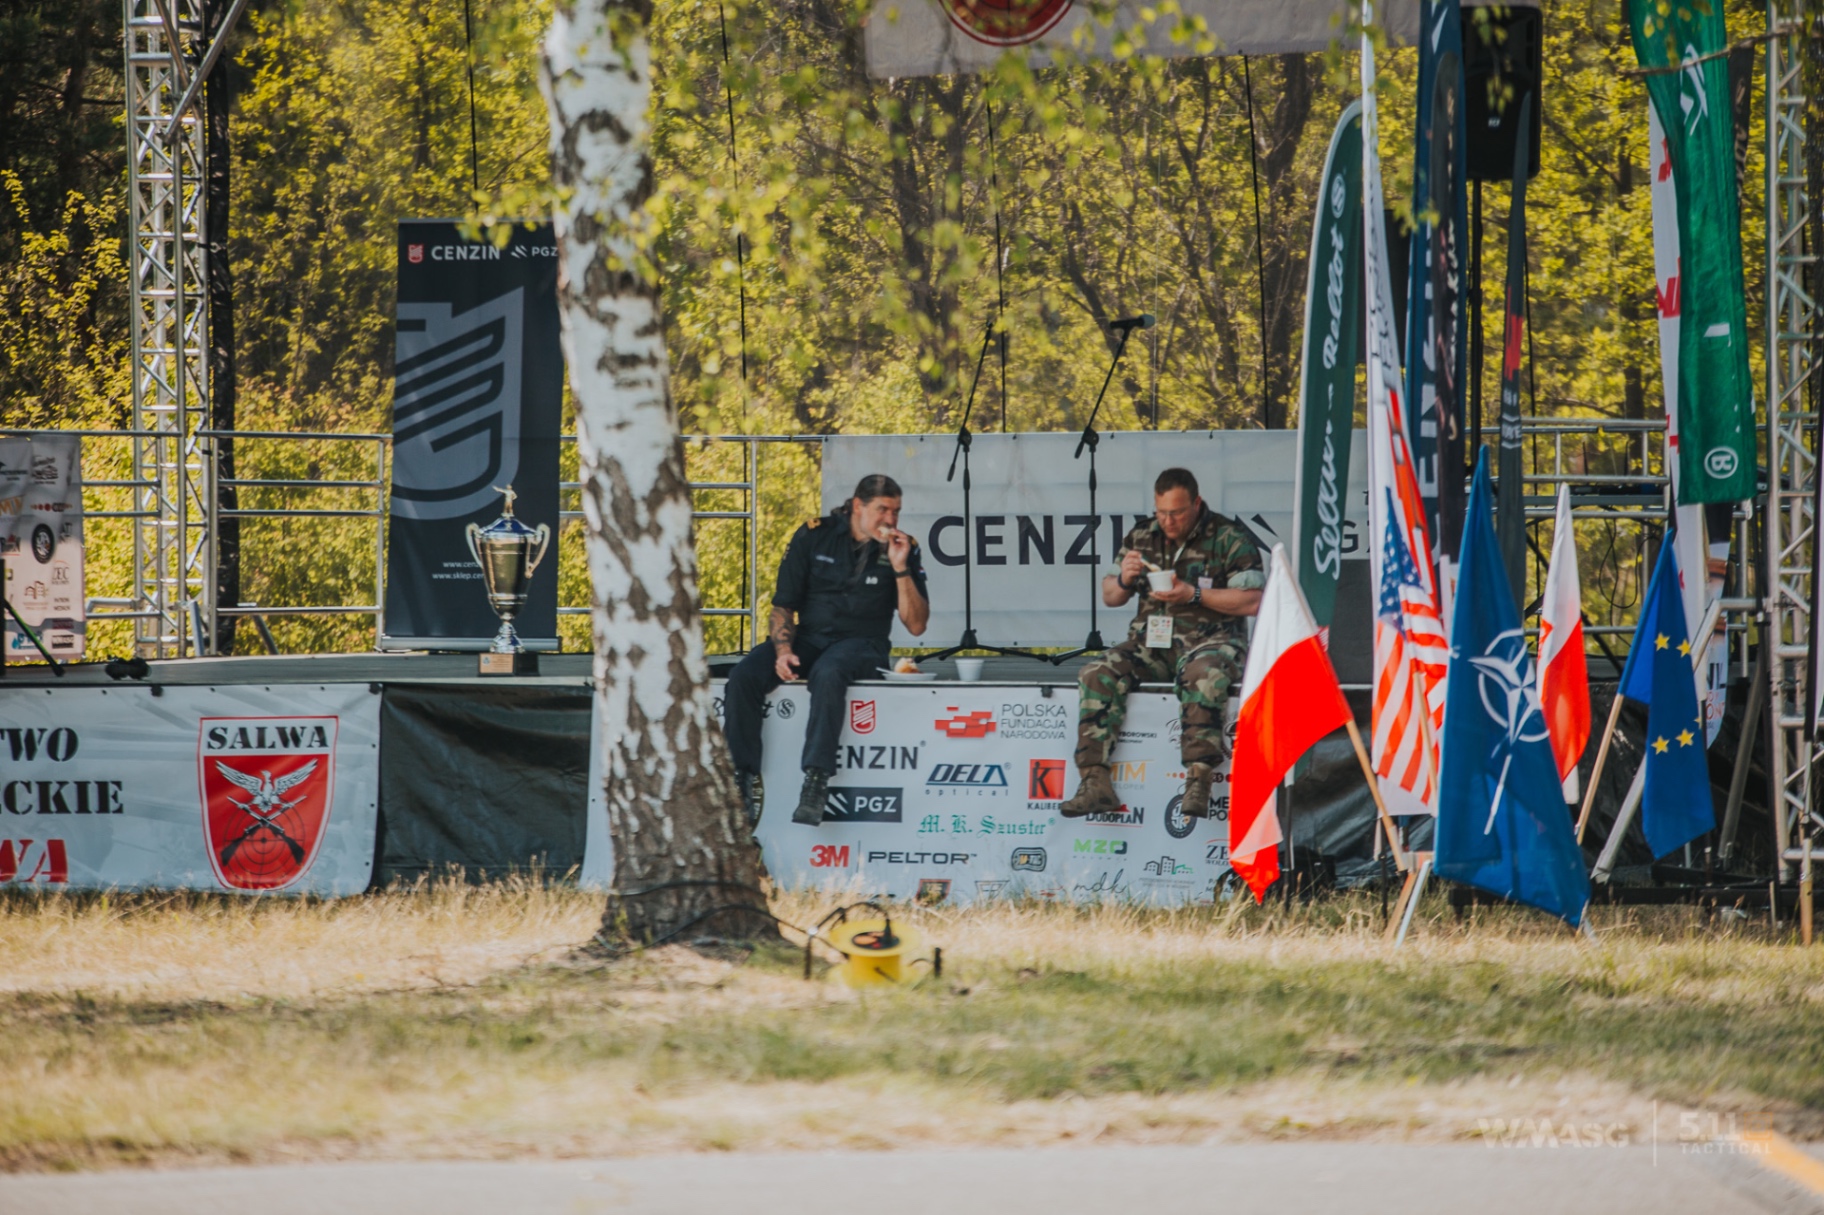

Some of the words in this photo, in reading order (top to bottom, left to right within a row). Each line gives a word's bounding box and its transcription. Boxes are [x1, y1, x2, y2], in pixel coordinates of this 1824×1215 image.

[432, 246, 500, 260] CENZIN
[532, 247, 558, 257] PGZ
[928, 515, 1148, 566] CENZI
[1002, 703, 1067, 718] POLSKA
[1001, 718, 1066, 729] FUNDACJA
[207, 725, 329, 750] SALWA
[1000, 730, 1066, 740] NARODOWA
[836, 745, 918, 770] NZIN
[0, 780, 124, 815] CKIE
[854, 796, 897, 813] PGZ
[810, 845, 849, 867] 3M
